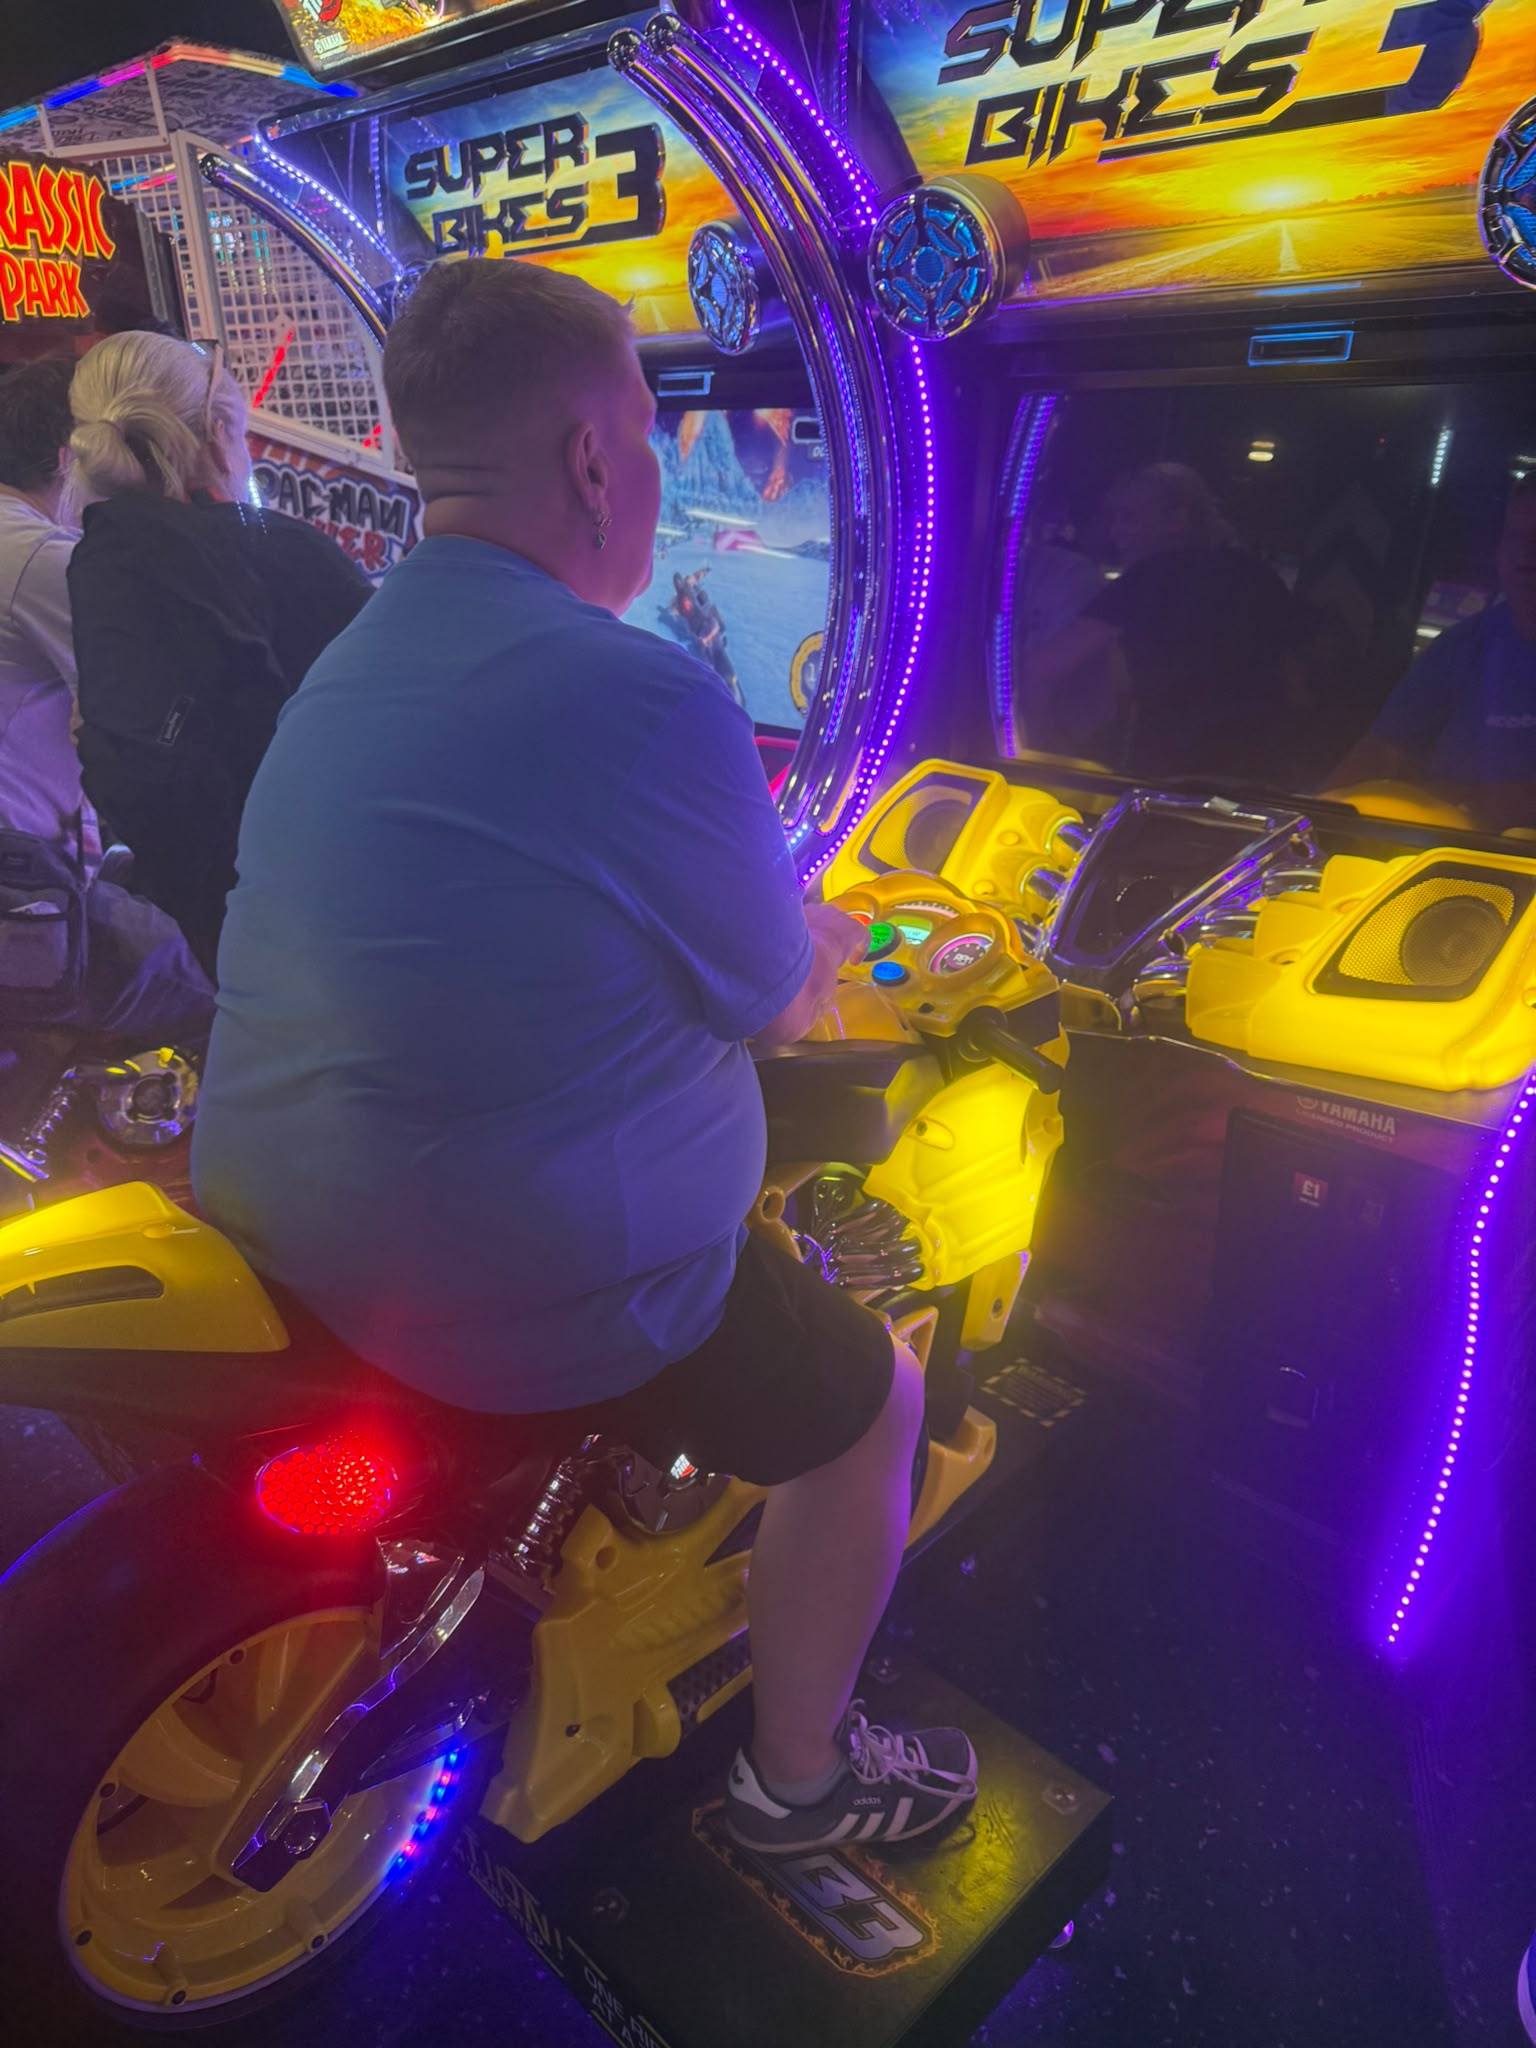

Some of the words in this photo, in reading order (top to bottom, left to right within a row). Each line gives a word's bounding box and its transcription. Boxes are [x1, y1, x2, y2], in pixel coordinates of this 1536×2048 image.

[937, 0, 1268, 85] SUP
[964, 30, 1316, 167] BIKES
[405, 112, 590, 203] SUPER
[434, 180, 592, 258] BIKES
[594, 122, 667, 240] 3
[0, 249, 90, 322] PARK
[254, 467, 407, 540] PAC-MAN
[1319, 1101, 1396, 1135] YAMAHA
[1301, 1180, 1321, 1199] £1
[853, 1797, 882, 1807] adidas
